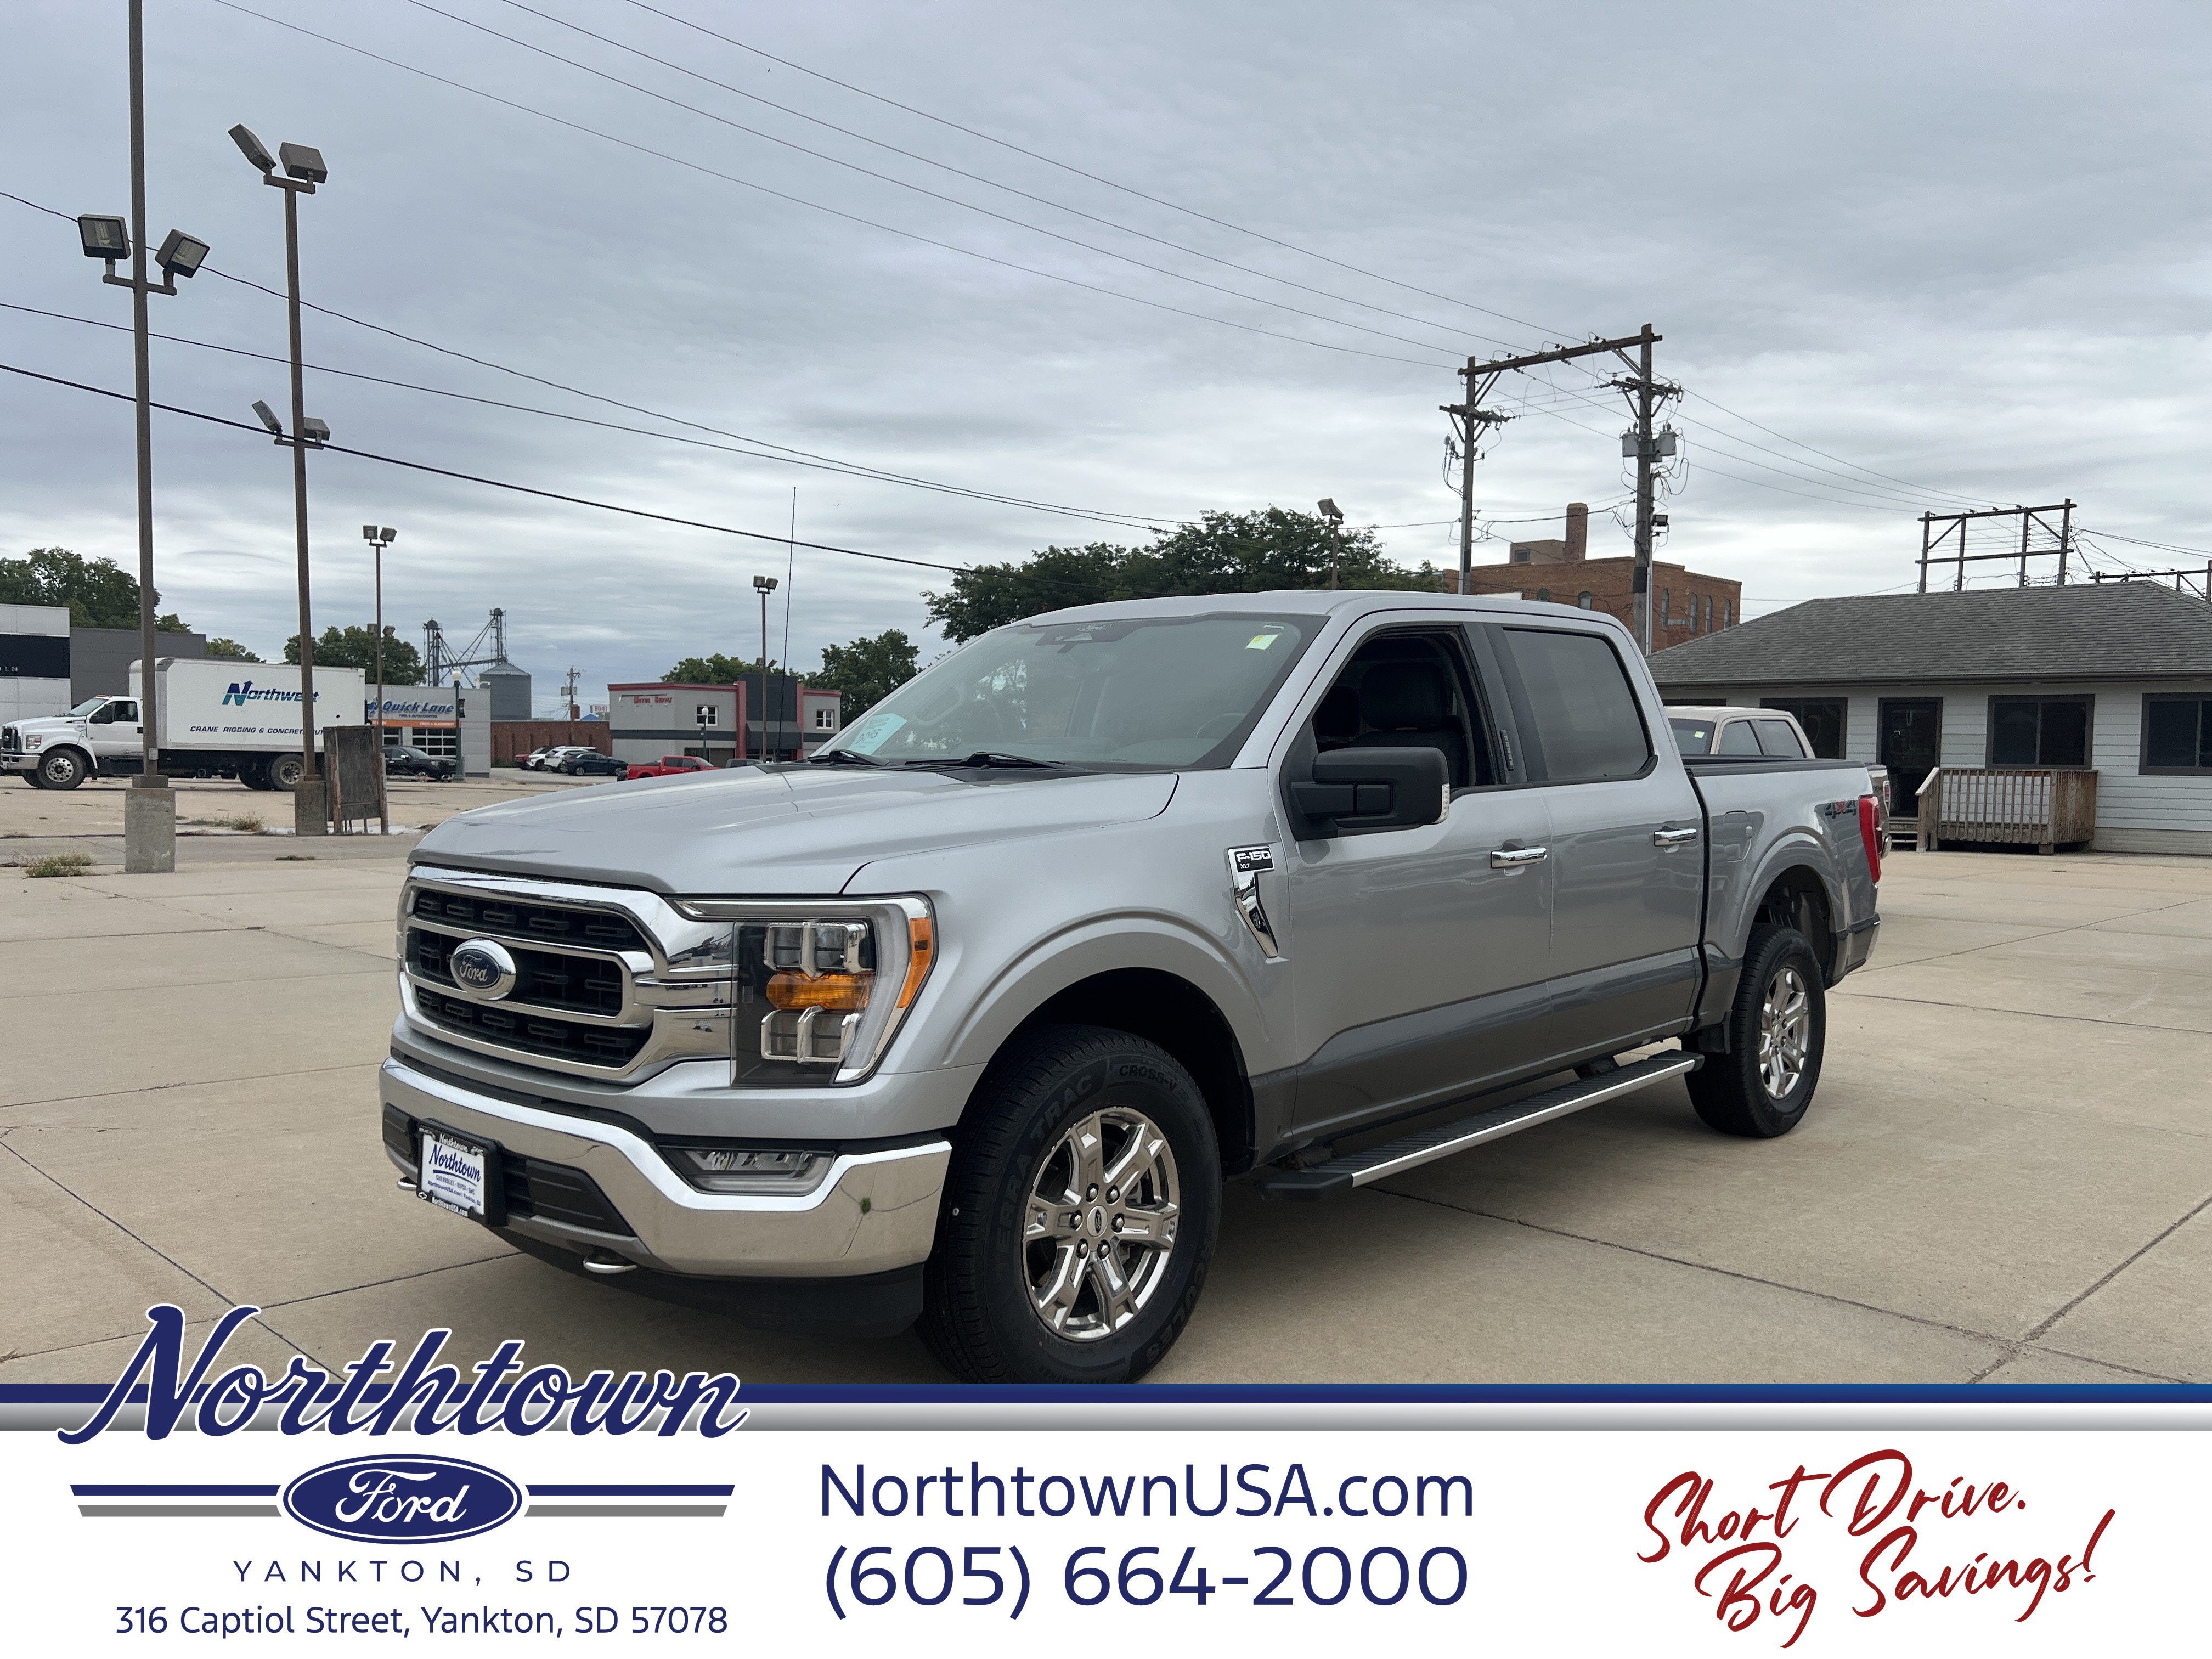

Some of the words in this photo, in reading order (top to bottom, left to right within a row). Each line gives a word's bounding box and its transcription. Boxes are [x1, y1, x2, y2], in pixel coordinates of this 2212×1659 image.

[222, 681, 320, 706] Northwet
[383, 701, 420, 713] Quick
[421, 702, 454, 713] Lane
[1236, 850, 1272, 862] F-150
[460, 954, 488, 982] Ford
[1120, 1064, 1177, 1091] CROSS-V
[1030, 1074, 1093, 1143] TRAC
[428, 1143, 481, 1182] Northtown
